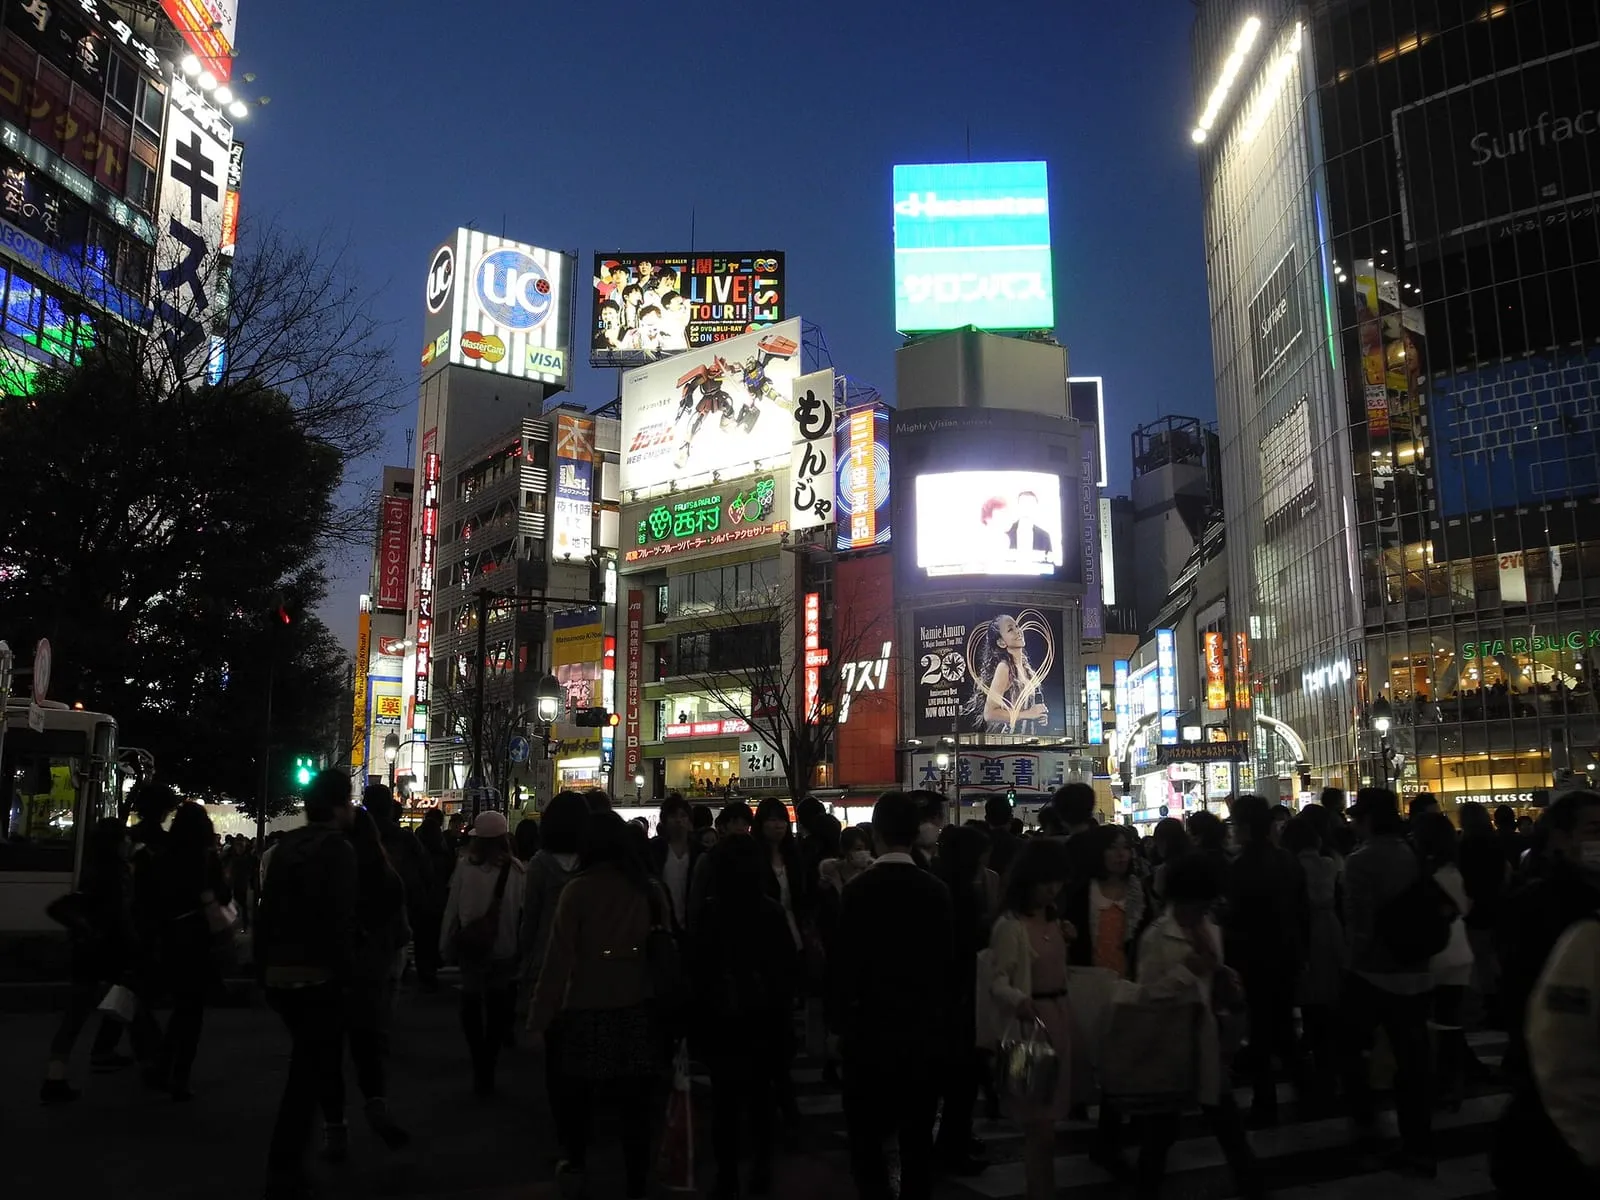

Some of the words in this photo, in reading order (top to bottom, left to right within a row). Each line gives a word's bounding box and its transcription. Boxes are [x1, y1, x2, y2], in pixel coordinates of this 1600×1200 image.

[4, 126, 17, 144] 7F
[1470, 109, 1600, 166] Surfac
[0, 222, 40, 263] EON
[690, 275, 747, 303] LIVE
[690, 304, 747, 319] TOUR!!
[461, 338, 505, 355] MasterCard
[700, 333, 712, 342] ON
[529, 352, 561, 370] VISA
[896, 422, 928, 433] Mighty
[794, 389, 832, 521] もんじゃ
[673, 506, 720, 537] 西村
[381, 499, 403, 602] Essential
[920, 625, 942, 641] Namie
[942, 624, 966, 638] Amuro
[382, 697, 400, 714] 薬
